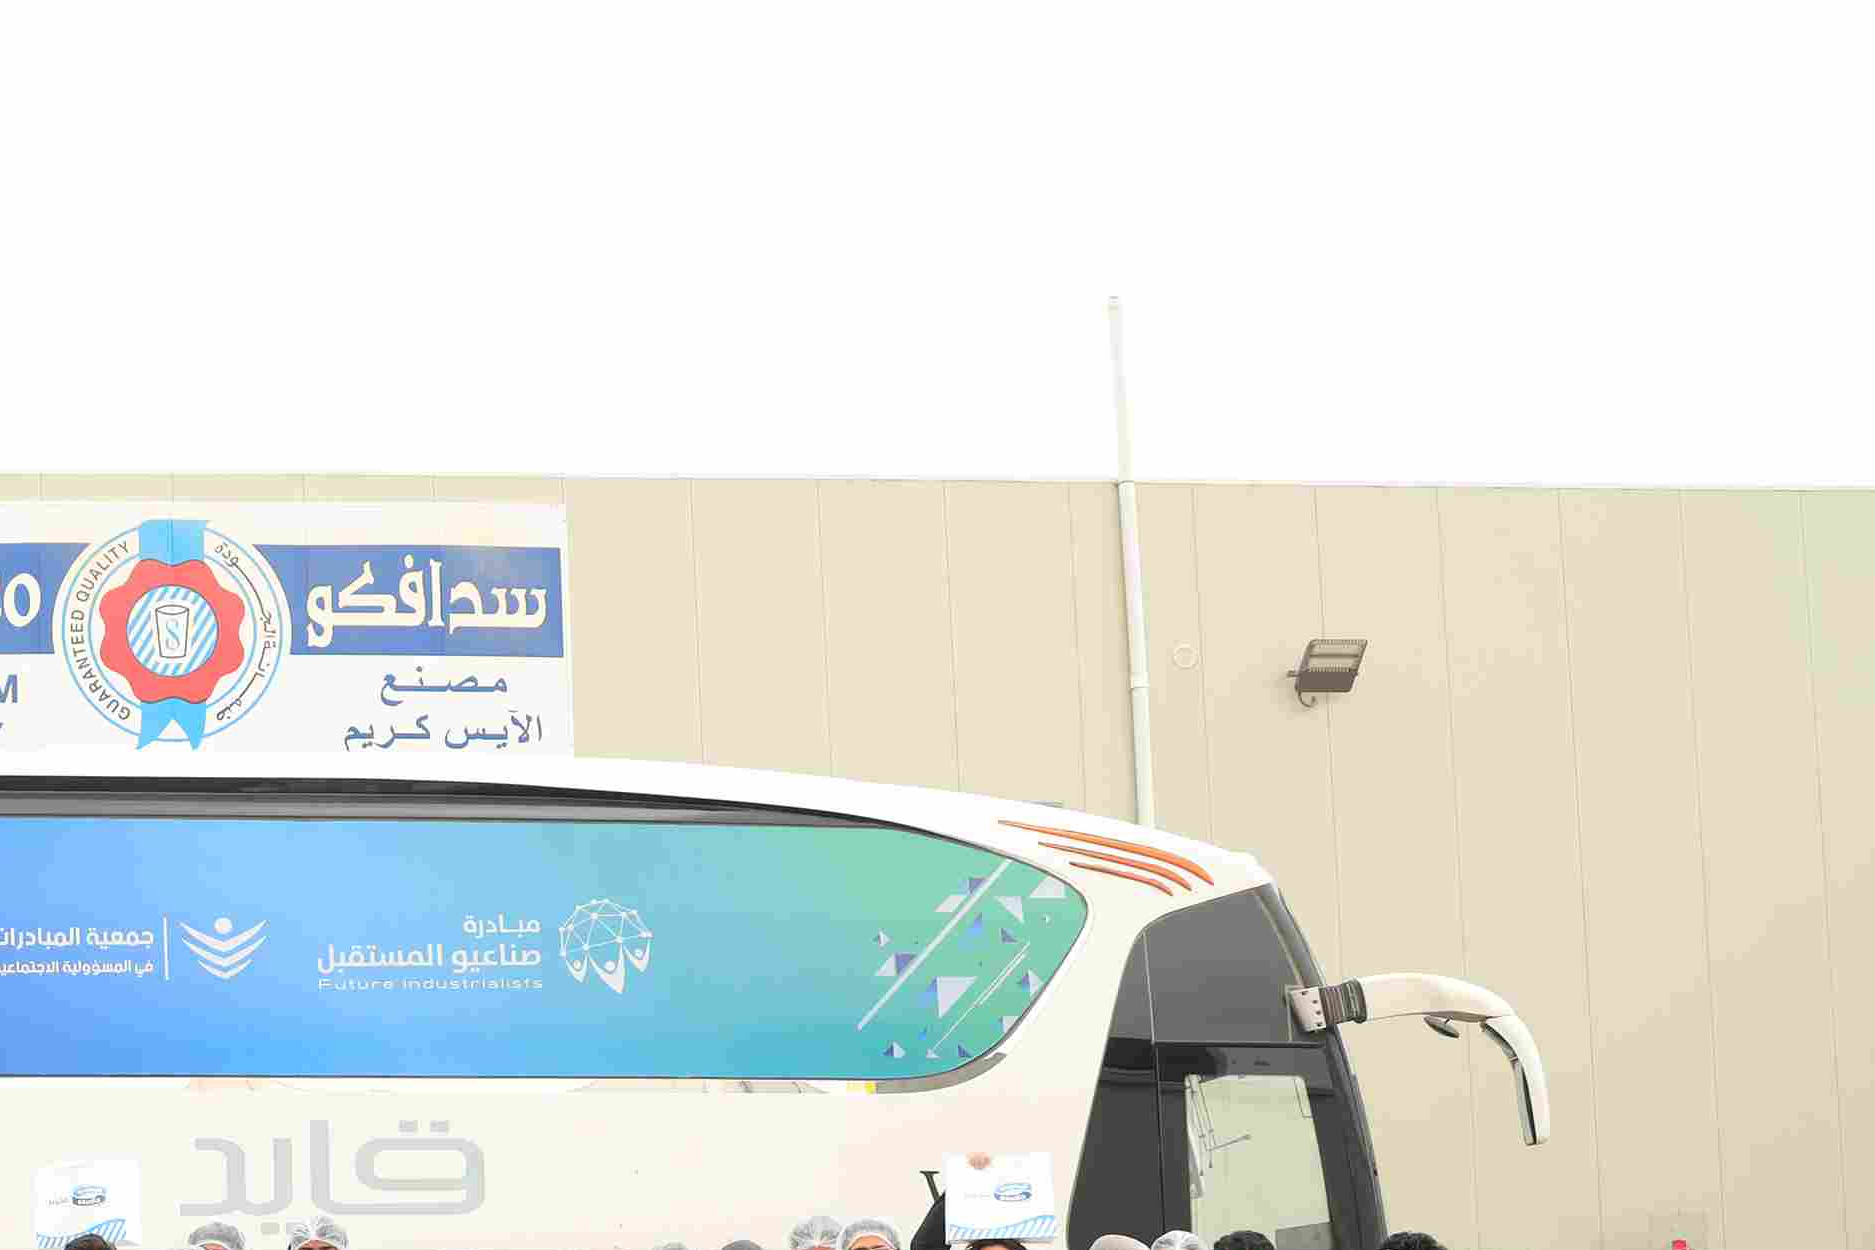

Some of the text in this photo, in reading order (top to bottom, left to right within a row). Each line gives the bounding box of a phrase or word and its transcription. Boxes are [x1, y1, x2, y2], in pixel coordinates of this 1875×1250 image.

[305, 554, 548, 648] سدافكو
[70, 541, 131, 721] GUARANTEED QUALITY
[380, 665, 508, 707] مصنع
[343, 714, 431, 752] كريم
[86, 927, 155, 950] جمعية
[462, 912, 542, 939] مبادرة
[317, 943, 445, 976] المستقبل
[317, 977, 544, 991] Future Industrialists
